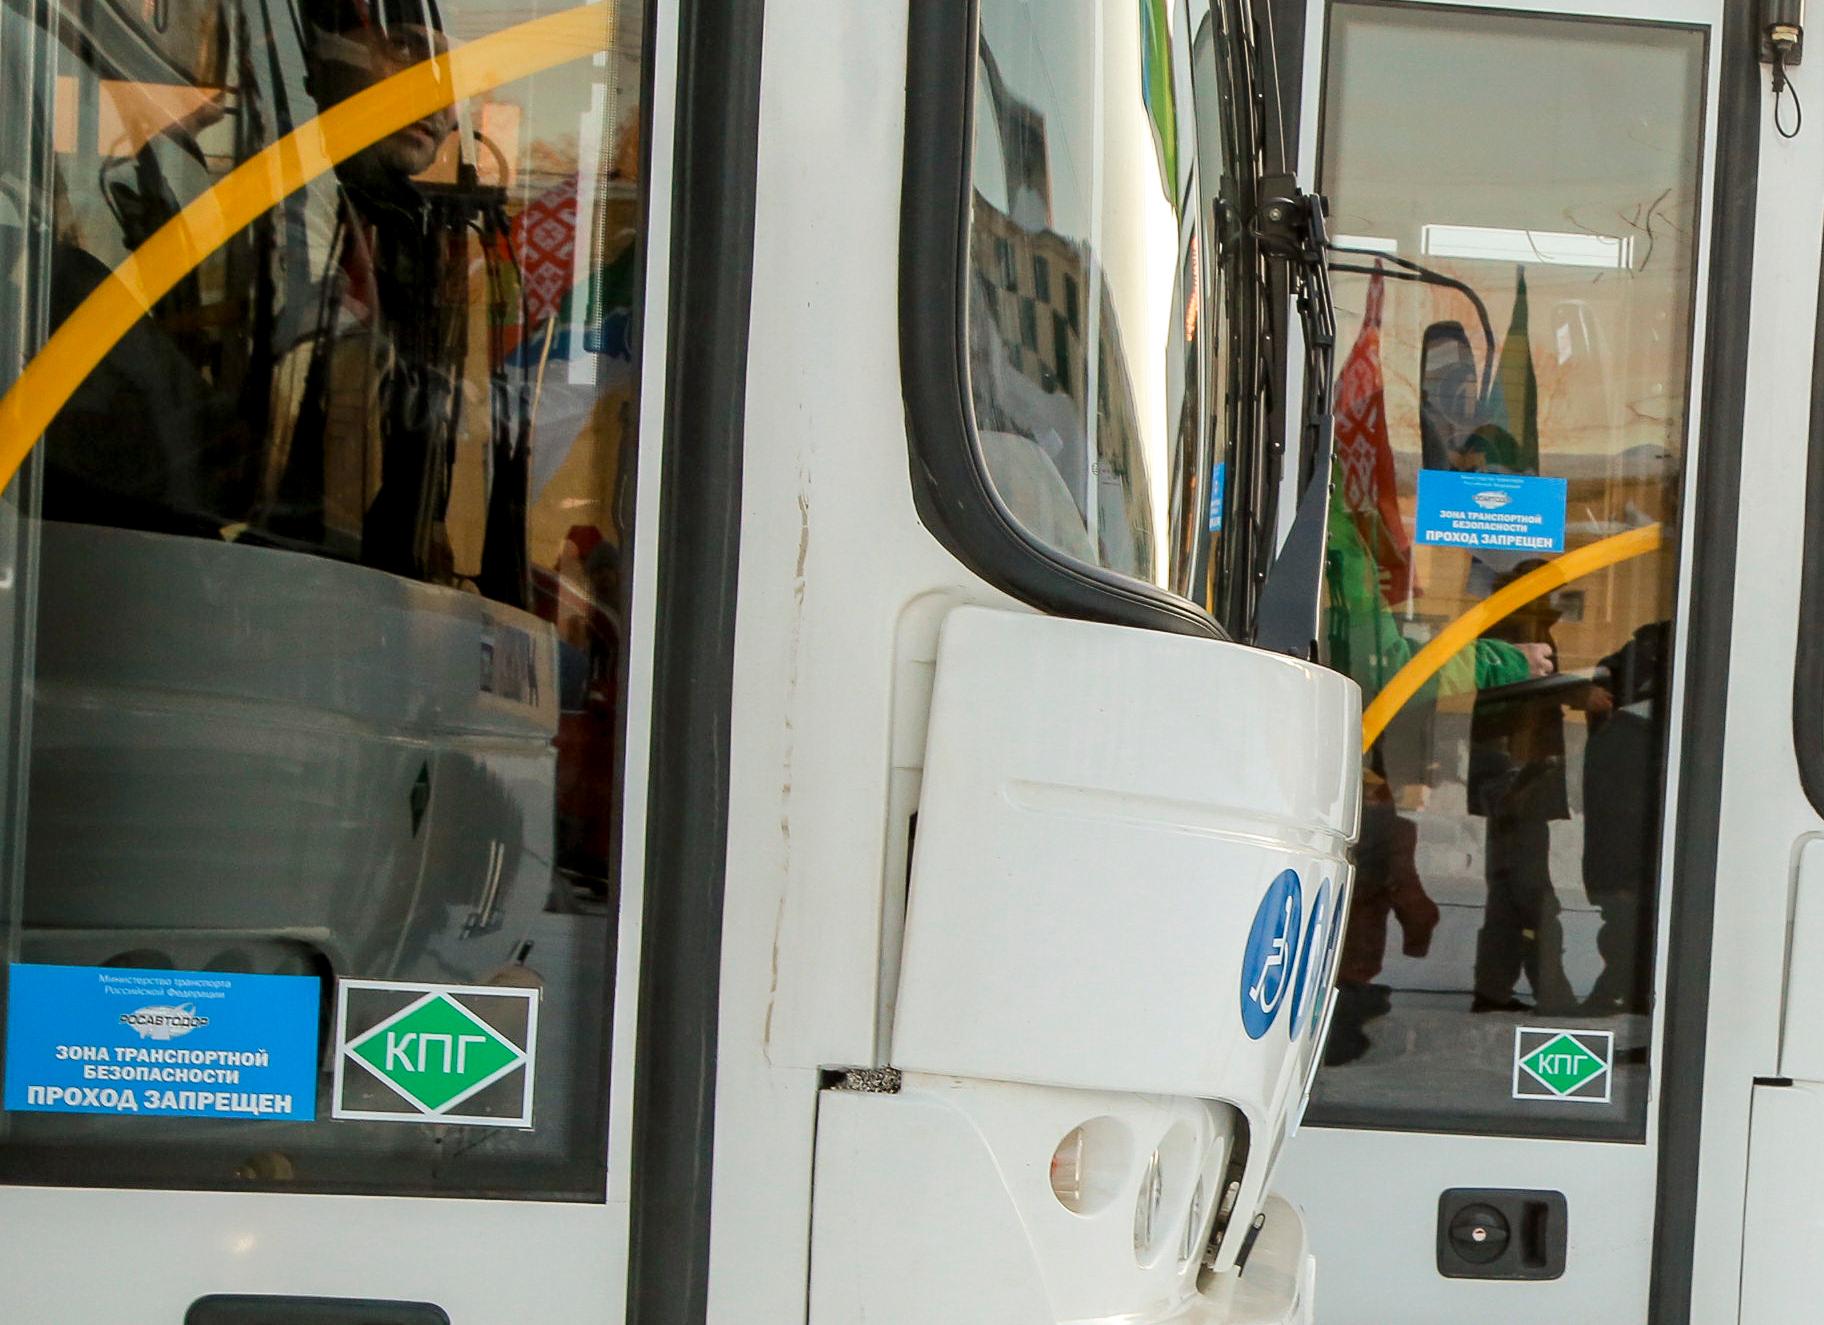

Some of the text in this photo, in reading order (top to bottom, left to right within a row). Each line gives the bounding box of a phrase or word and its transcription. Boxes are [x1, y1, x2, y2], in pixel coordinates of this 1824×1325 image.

[1439, 510, 1543, 524] ЗОНА ТРАНСПОРТНОЙ
[1452, 520, 1529, 533] БЕЗОПАСНОСТИ
[1425, 530, 1554, 549] ПРОХОД ЗАПРЕЩЕН
[98, 974, 232, 989] Министерство транспорта
[104, 984, 225, 999] Российской Федерации
[119, 1014, 210, 1028] РОСАВТОДОР
[55, 1045, 270, 1068] ЗОНА ТРАНСПОРТНОЙ
[384, 1030, 488, 1075] КПГ
[82, 1063, 241, 1084] БЕЗОПАСНОСТИ
[1538, 1053, 1589, 1076] КПГ
[26, 1084, 294, 1116] ПРОХОД ЗАПРЕЩЕН
